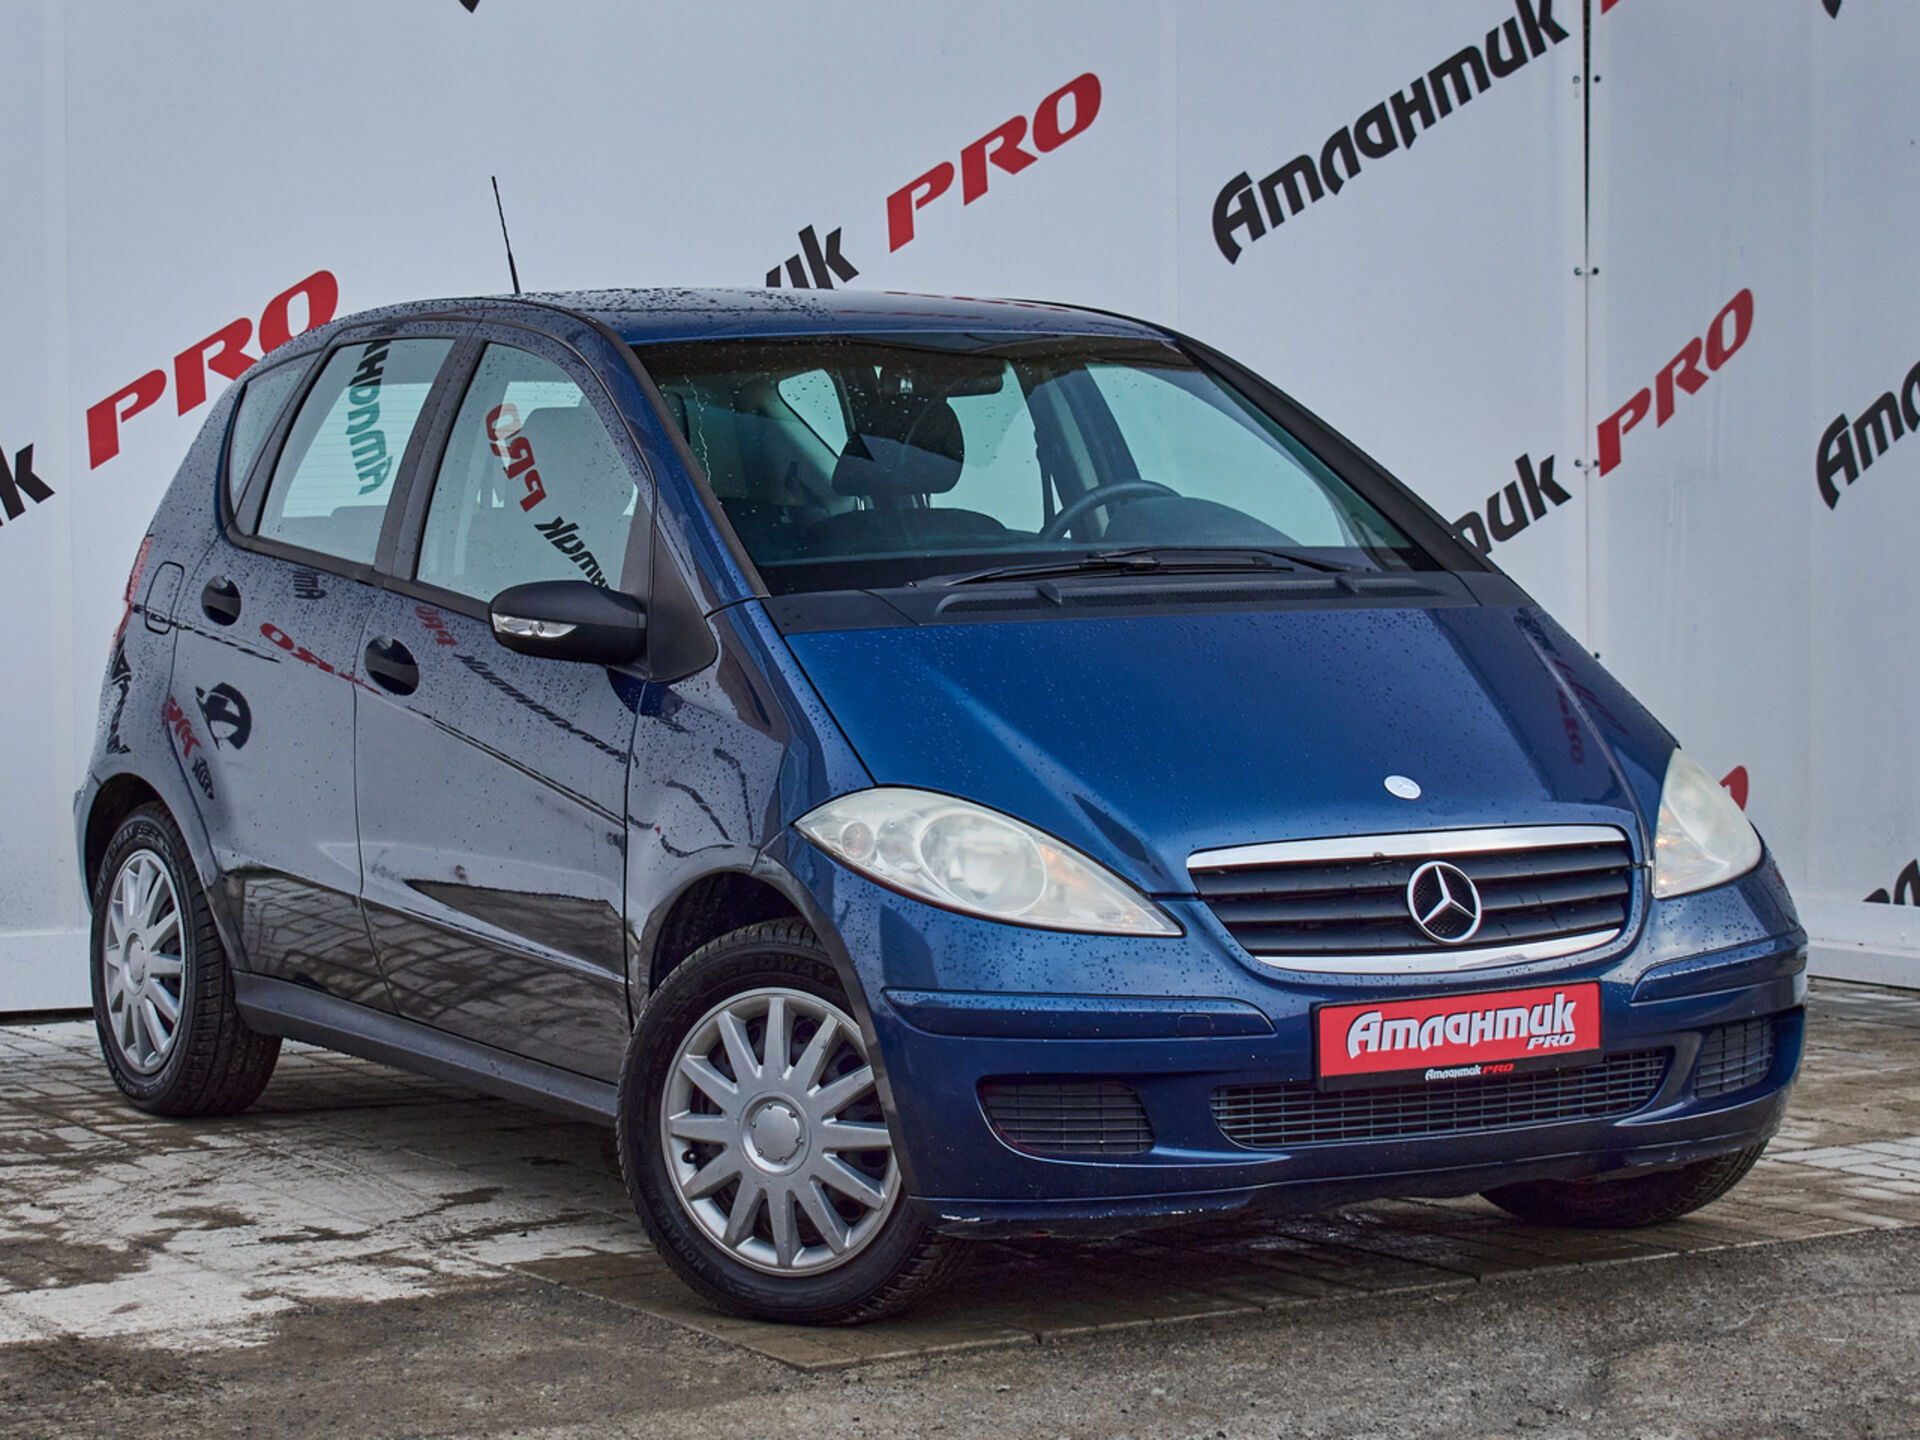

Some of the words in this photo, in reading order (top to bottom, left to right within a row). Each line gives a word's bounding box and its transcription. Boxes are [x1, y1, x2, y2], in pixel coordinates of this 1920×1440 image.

[886, 72, 1102, 253] PRO
[86, 270, 338, 470] PRO
[1597, 288, 1754, 477] PRO
[1347, 993, 1576, 1059] Атлантик
[1482, 1063, 1514, 1074] PRO
[1526, 1033, 1576, 1050] PRO
